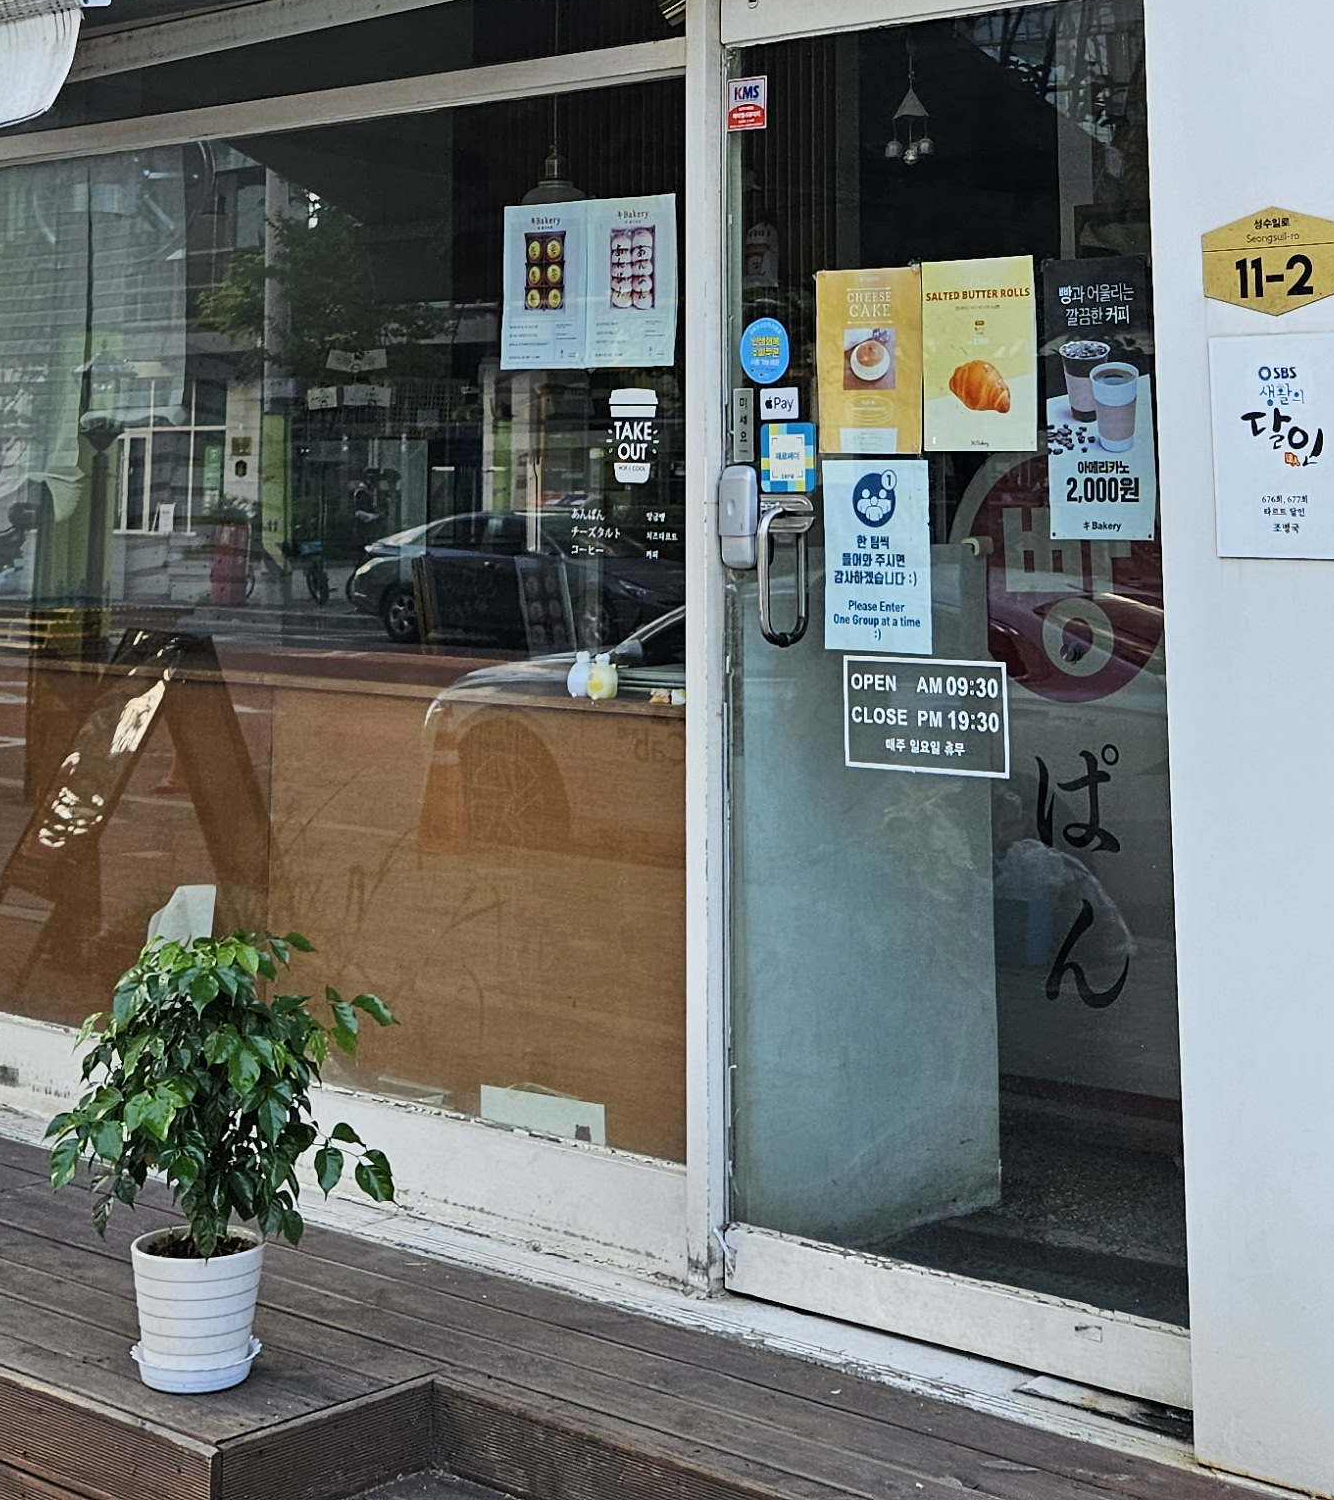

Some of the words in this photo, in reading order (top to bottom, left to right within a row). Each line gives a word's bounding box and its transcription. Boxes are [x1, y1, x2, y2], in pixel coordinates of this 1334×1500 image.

[734, 85, 760, 101] KMS
[1254, 217, 1290, 230] 성수일로
[1246, 232, 1300, 244] Seongsuil-ro
[1235, 254, 1314, 299] 11-2
[846, 291, 892, 303] CHEESE
[926, 291, 960, 302] SALTED
[962, 289, 998, 300] BUTTER
[1000, 287, 1030, 298] ROLLS
[1058, 285, 1085, 305] 빵과
[1086, 283, 1135, 303] 어울리는
[849, 303, 891, 318] CAKE
[1065, 306, 1103, 326] 깔끔한
[1105, 305, 1130, 325] 커피
[1273, 367, 1297, 380] SBS
[1259, 383, 1305, 406] 생활의
[774, 396, 794, 412] Pay
[739, 397, 748, 443] 미세요
[613, 421, 652, 441] TAKE
[1240, 407, 1324, 467] 달인
[617, 443, 648, 461] OUT
[1077, 460, 1130, 474] 아메리카노
[1066, 477, 1140, 504] 2,000원
[570, 508, 606, 522] あんぱん
[1289, 507, 1305, 517] 달인
[570, 526, 621, 539] チーズタルト
[1091, 520, 1122, 532] Bakery
[570, 544, 604, 556] コーヒー
[856, 535, 867, 549] 한
[870, 535, 890, 550] 팀씩
[646, 550, 659, 560] 커피
[842, 553, 873, 567] 들어와
[875, 553, 906, 568] 주시면
[834, 570, 905, 585] 감사하겠습니다
[848, 600, 878, 612] Please
[879, 601, 905, 613] Enter
[833, 613, 850, 625] One
[852, 614, 879, 628] Group
[881, 617, 890, 627] at
[892, 618, 898, 627] a
[900, 616, 921, 628] time
[850, 673, 897, 692] OPEN
[916, 676, 943, 694] AM
[946, 675, 999, 699] 09:30
[851, 706, 908, 726] CLOSE
[917, 710, 943, 728] PM
[947, 710, 999, 733] 19:30
[885, 738, 906, 752] 매주
[909, 739, 940, 755] 일요일
[944, 741, 966, 756] 휴무
[1034, 743, 1130, 1010] ぱん
